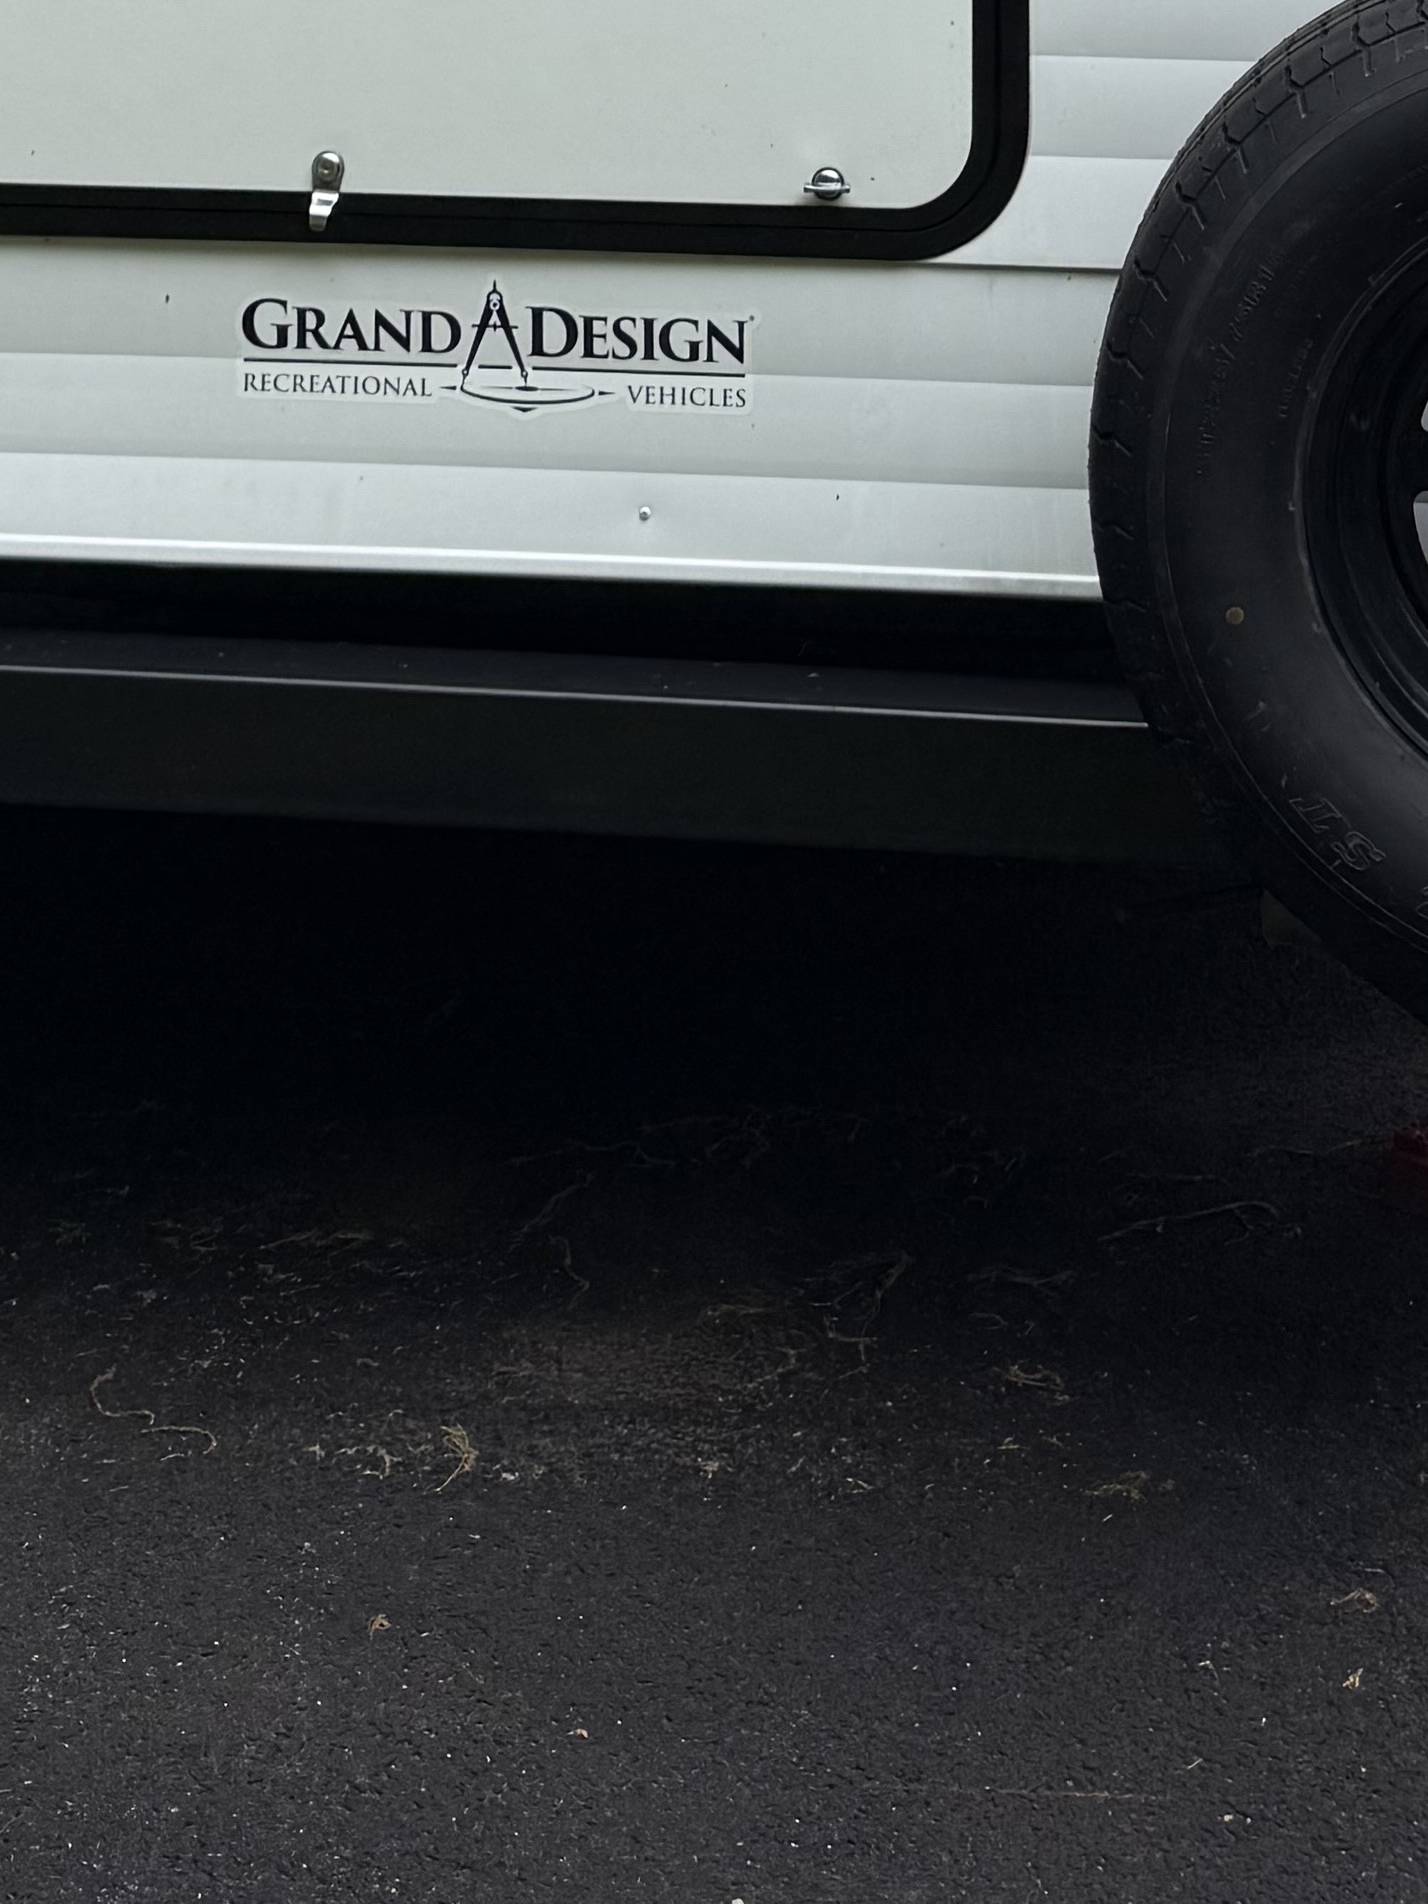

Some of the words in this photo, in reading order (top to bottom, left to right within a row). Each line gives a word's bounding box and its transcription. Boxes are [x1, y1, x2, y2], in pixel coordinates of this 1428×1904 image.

[242, 298, 462, 355] GRAND
[527, 304, 746, 364] DESIGN
[243, 372, 433, 398] RECREATIONAL
[627, 384, 748, 408] VEHICLES
